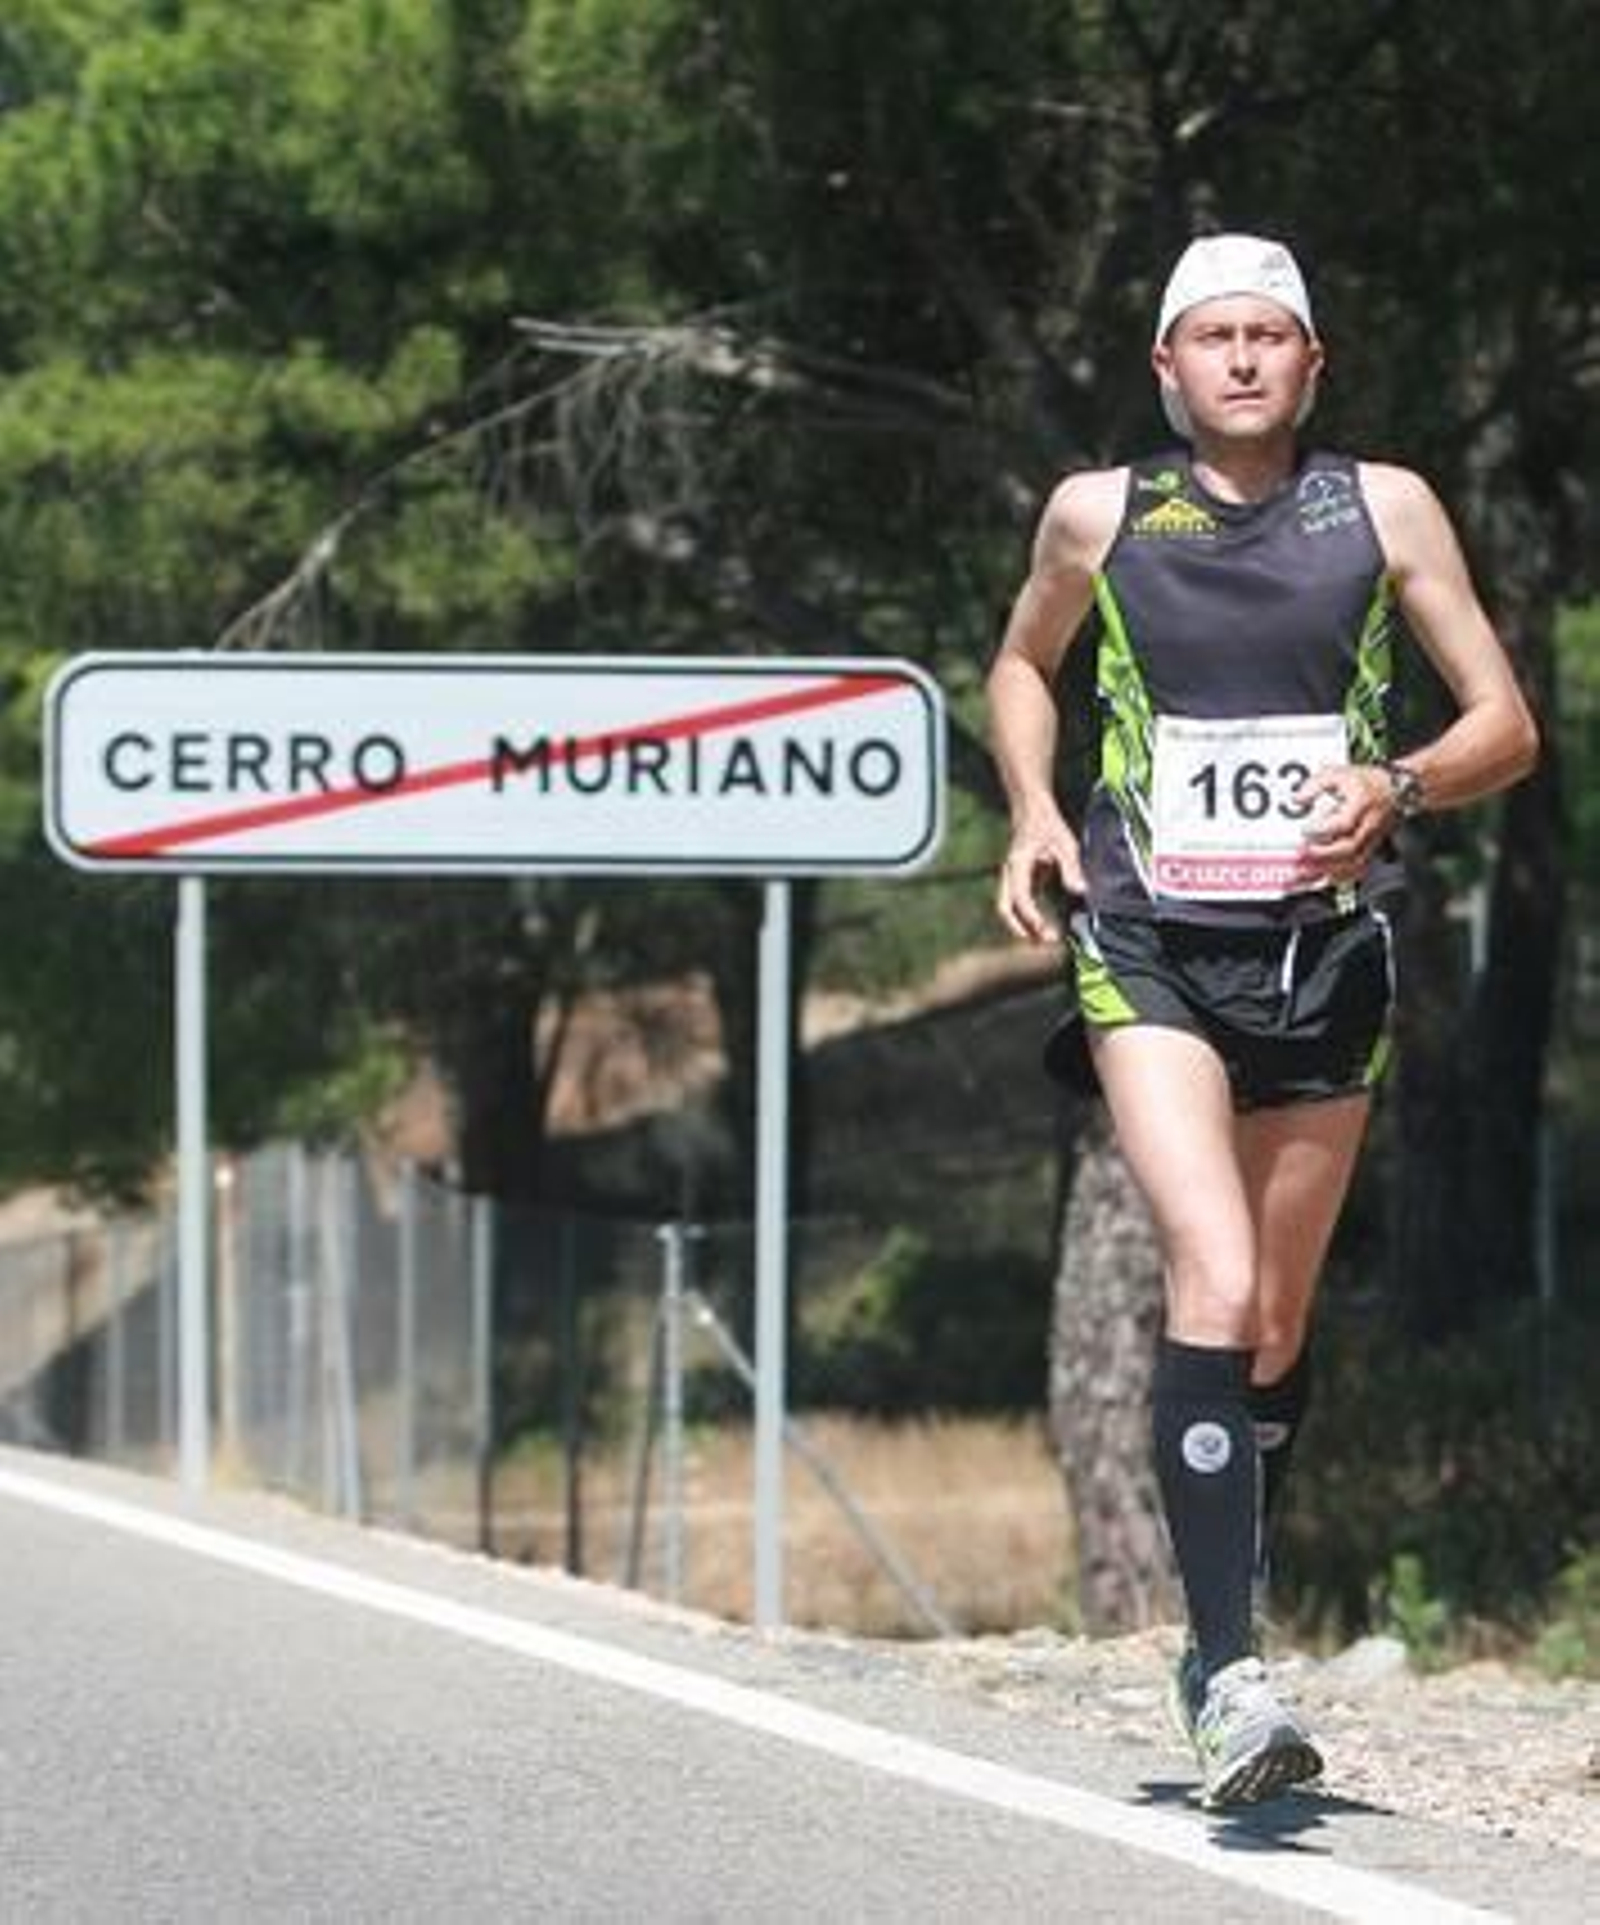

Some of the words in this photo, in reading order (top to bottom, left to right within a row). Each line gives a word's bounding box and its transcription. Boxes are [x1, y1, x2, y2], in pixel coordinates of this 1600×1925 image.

[103, 731, 405, 793] CERRO
[491, 734, 903, 798] MURIANO
[1188, 761, 1315, 819] 163
